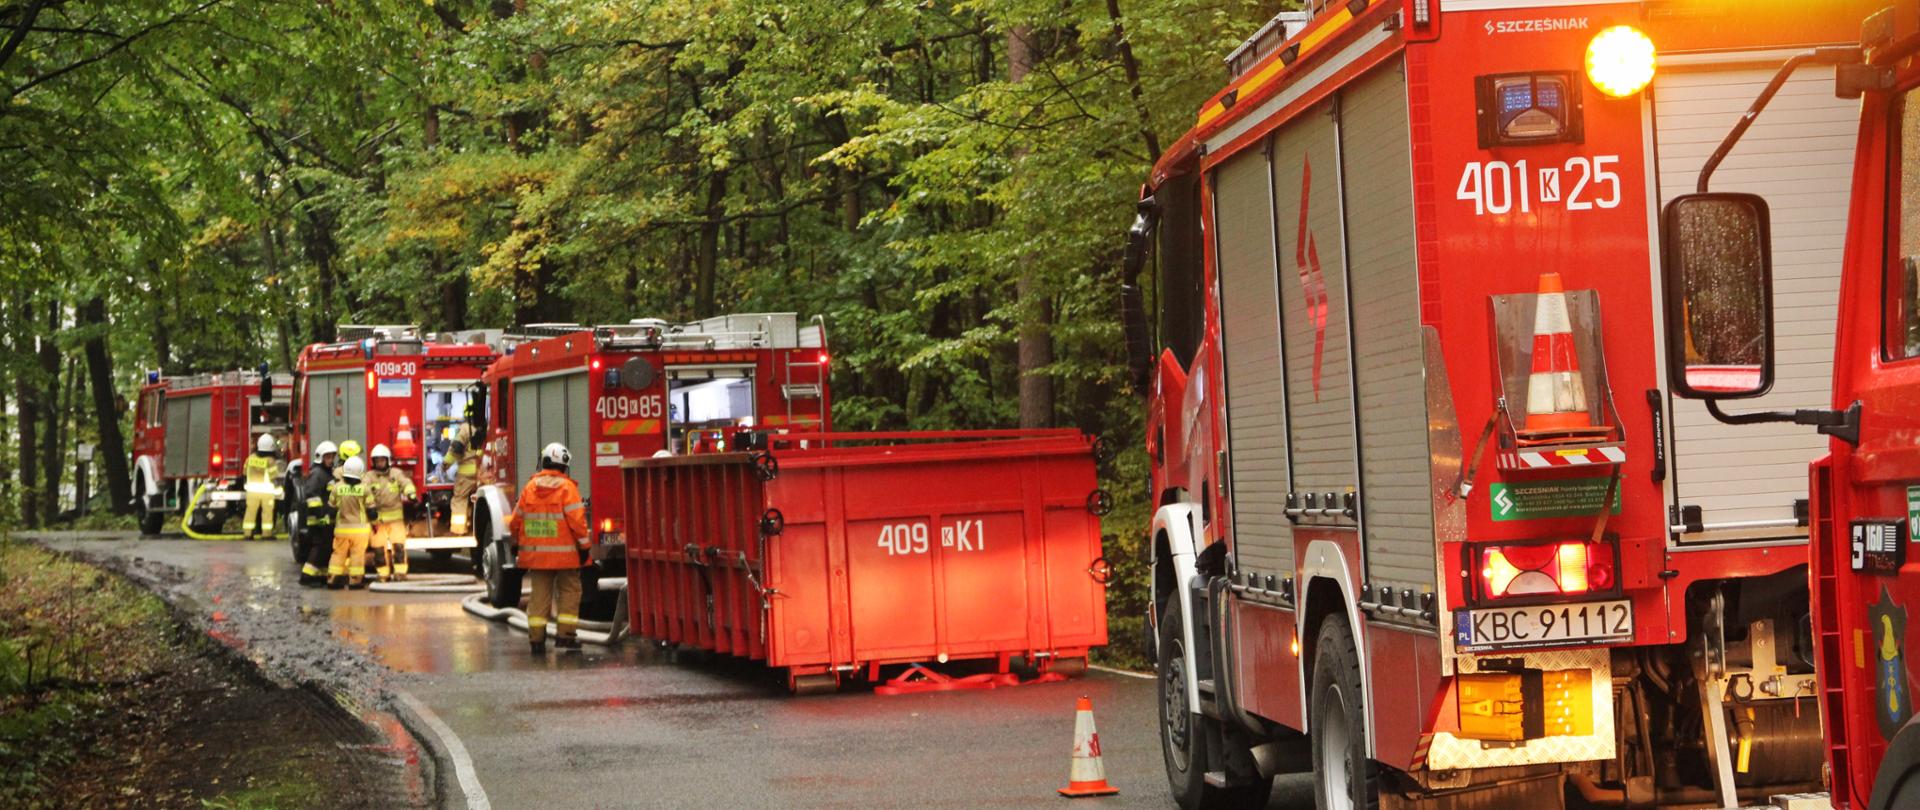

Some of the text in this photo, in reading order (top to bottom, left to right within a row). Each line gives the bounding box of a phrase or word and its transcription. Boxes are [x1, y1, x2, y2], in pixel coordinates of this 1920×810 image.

[1496, 17, 1589, 33] SZCZĘŚNIAK
[1456, 155, 1621, 216] 401 K 25
[373, 361, 395, 376] 409
[401, 361, 416, 376] 30
[595, 395, 628, 419] 409
[640, 394, 662, 418] 85
[877, 519, 984, 556] 409 K K1
[1458, 603, 1629, 643] PL KBC 91112
